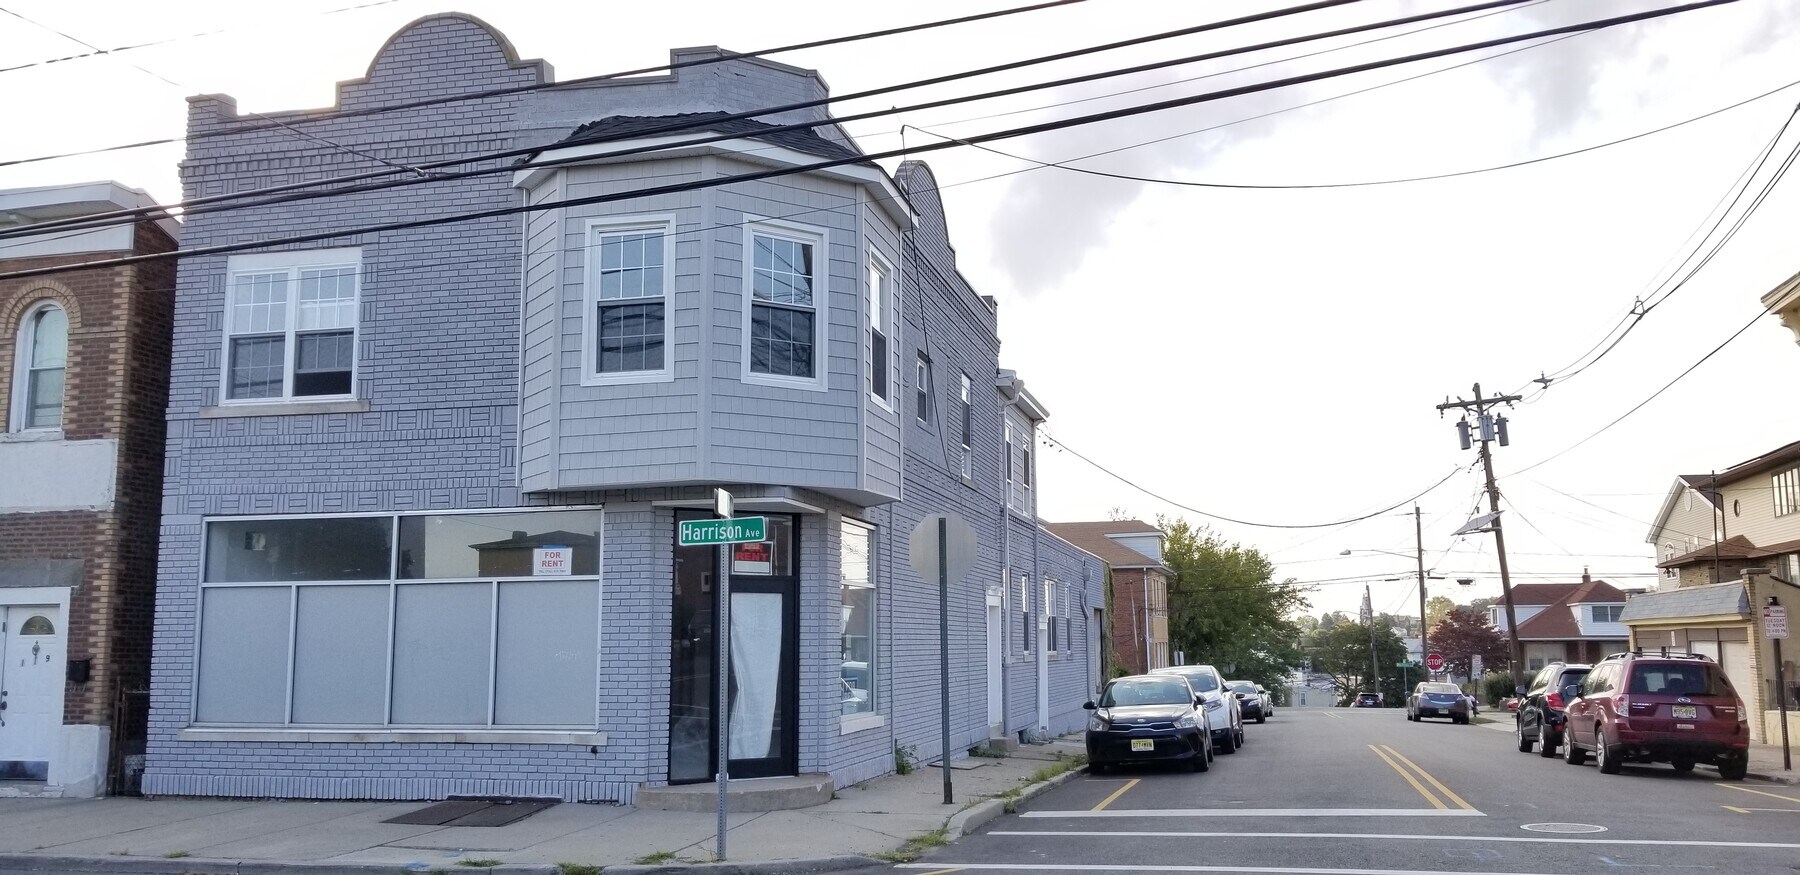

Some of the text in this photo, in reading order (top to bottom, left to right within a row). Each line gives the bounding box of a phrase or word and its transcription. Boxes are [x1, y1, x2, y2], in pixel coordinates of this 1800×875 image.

[682, 523, 760, 541] Harrison Ave
[544, 551, 561, 559] FOR
[735, 551, 768, 561] RENT
[45, 654, 50, 662] 9
